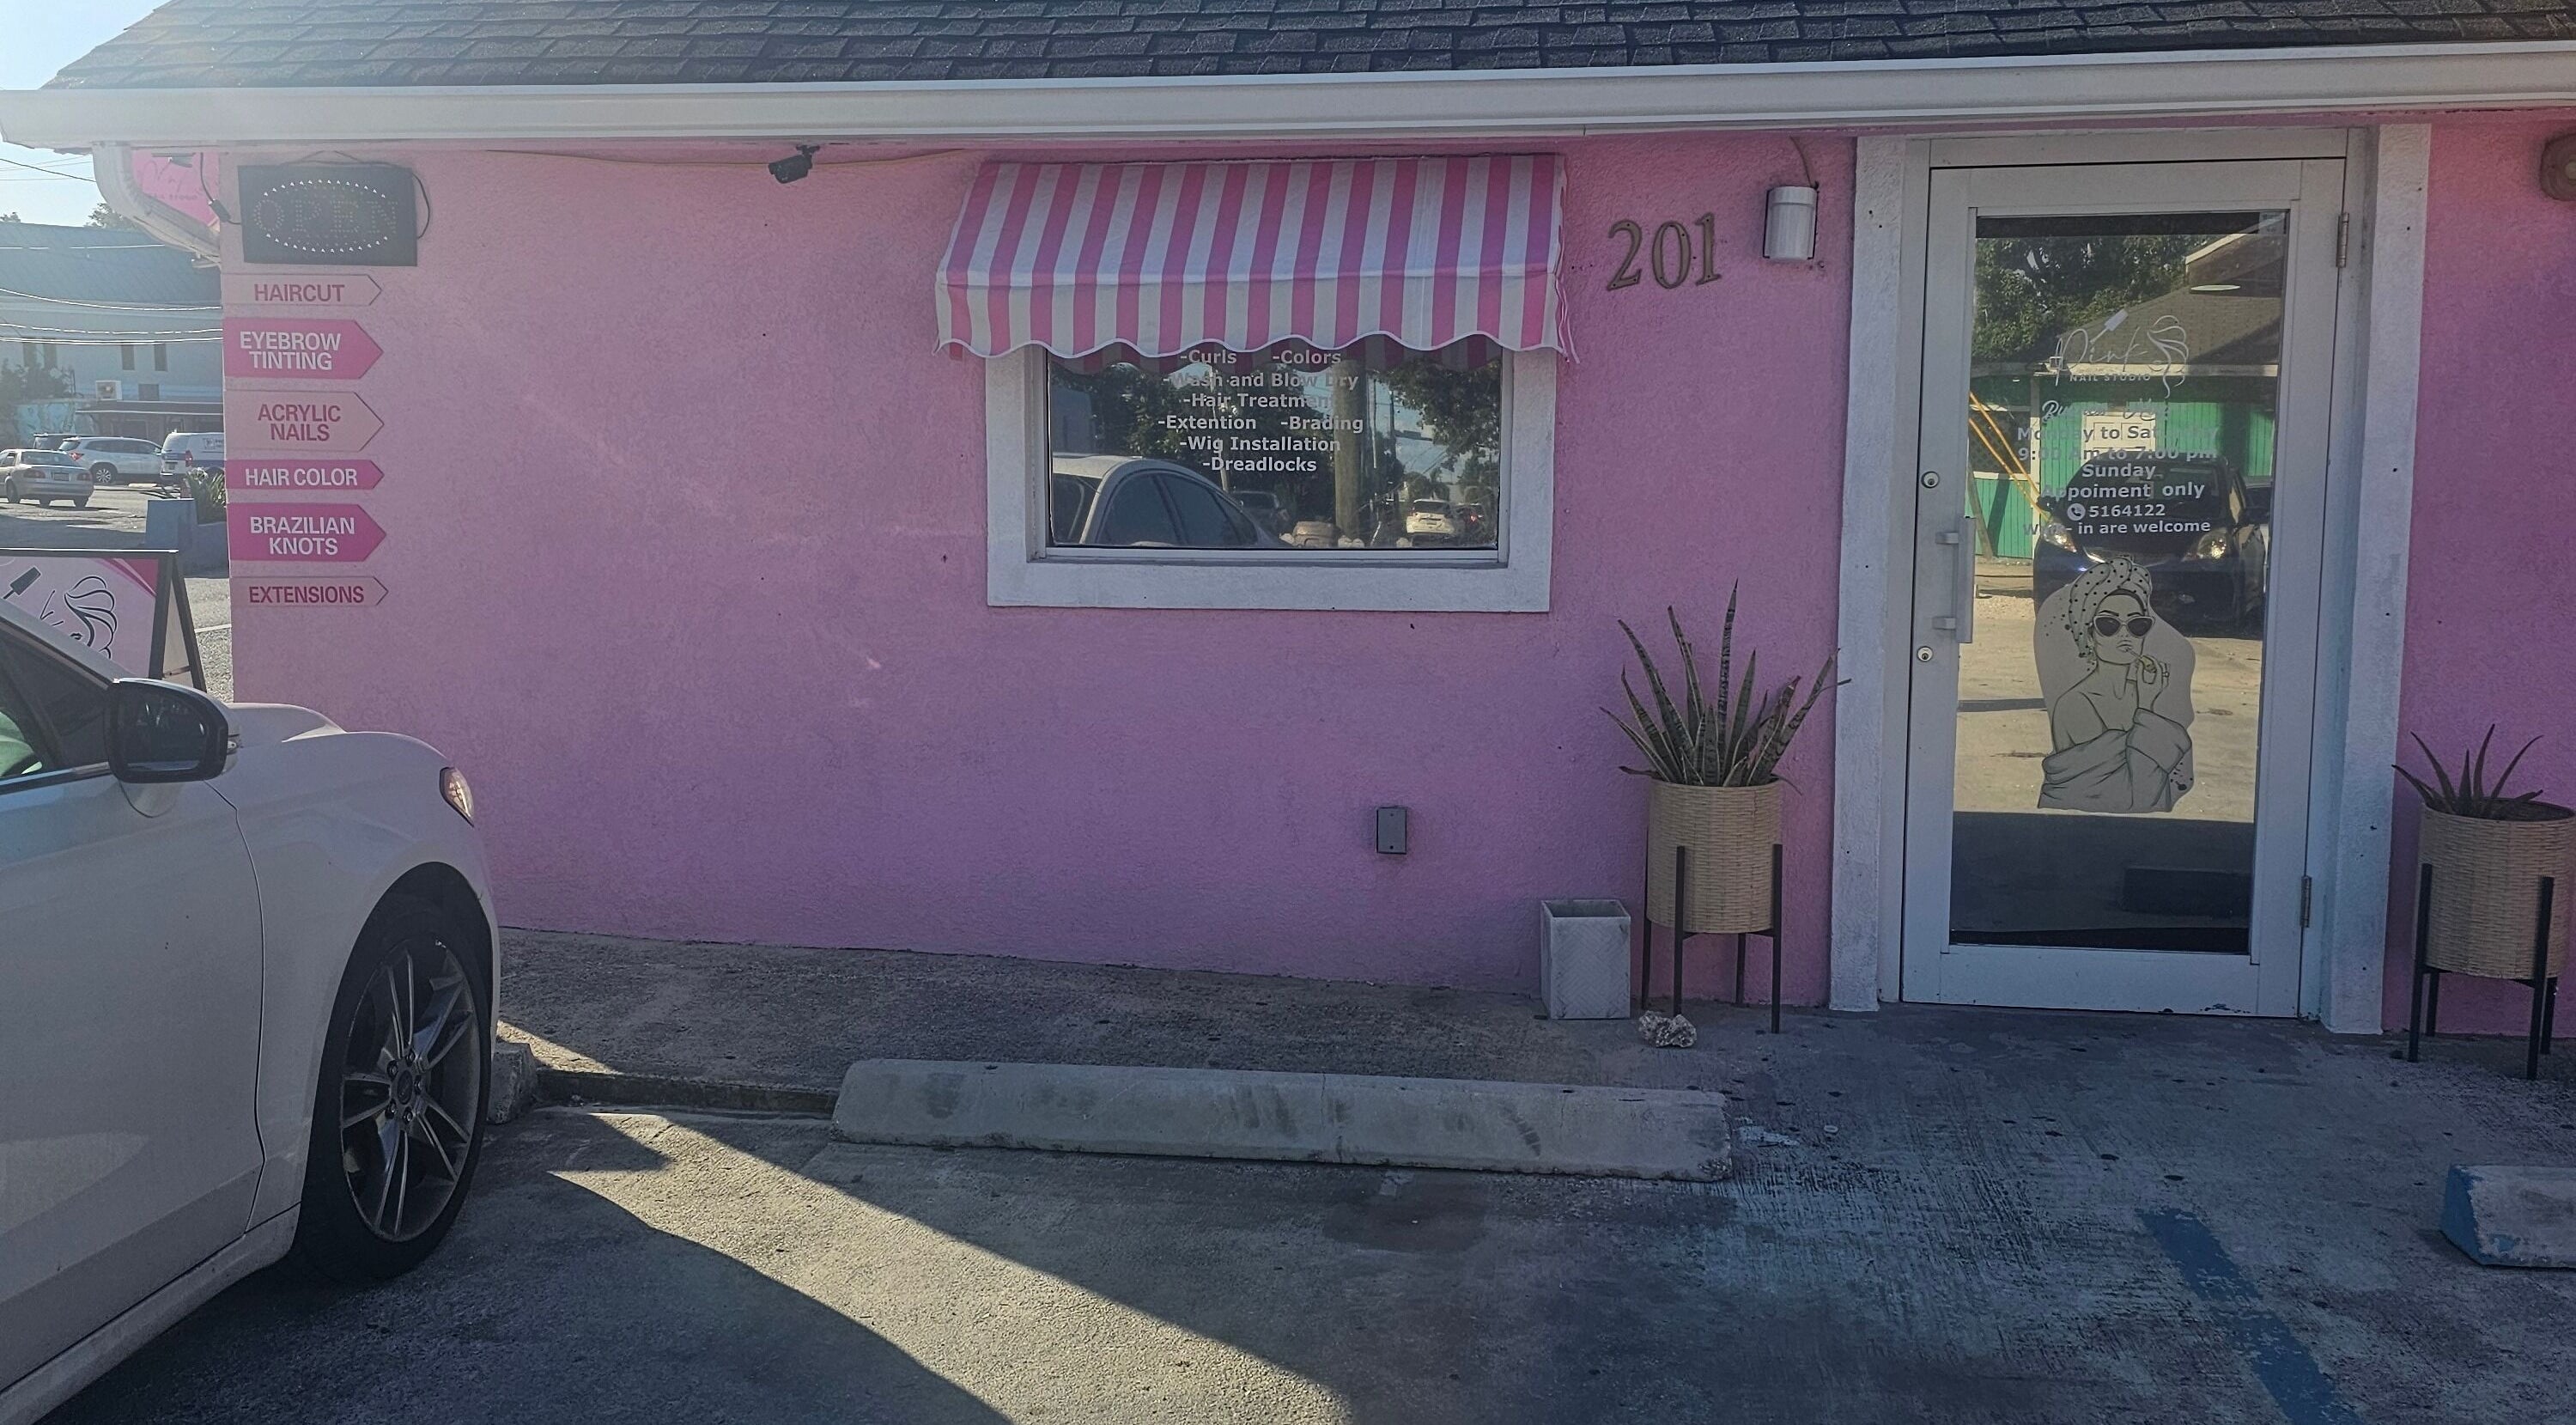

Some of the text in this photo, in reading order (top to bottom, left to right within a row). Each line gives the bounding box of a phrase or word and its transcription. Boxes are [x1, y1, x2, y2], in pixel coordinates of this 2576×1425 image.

[254, 199, 398, 234] OPEN
[1607, 212, 1722, 291] 201
[253, 283, 345, 303] HAIRCUT
[240, 331, 342, 351] EYEBROW
[249, 351, 332, 370] TINTING
[1180, 349, 1342, 365] -Curls -Colors
[1229, 372, 1265, 387] and
[1271, 372, 1318, 387] Blow
[2104, 374, 2151, 382] STUDIO
[1183, 393, 1336, 409] -Hair Treatmen
[257, 404, 342, 423] ACRYLIC
[270, 423, 331, 442] NAILS
[1157, 415, 1364, 434] -Extention -Brading
[2100, 426, 2120, 440] to
[1179, 435, 1340, 453] -Wig Installation
[2108, 447, 2127, 460] to
[2136, 447, 2179, 460] 7:00
[1202, 456, 1317, 472] -Dreadlocks
[2081, 462, 2156, 479] Sunday
[245, 468, 358, 487] HAIR COLOR
[2041, 482, 2205, 501] Appoiment only
[2088, 503, 2166, 518] 5164122
[249, 515, 355, 536] BRAZILIAN
[2078, 521, 2093, 534] in
[2099, 523, 2128, 534] are
[2133, 520, 2211, 533] welcome
[269, 537, 338, 557] KNOTS
[248, 585, 365, 604] EXTENSIONS
